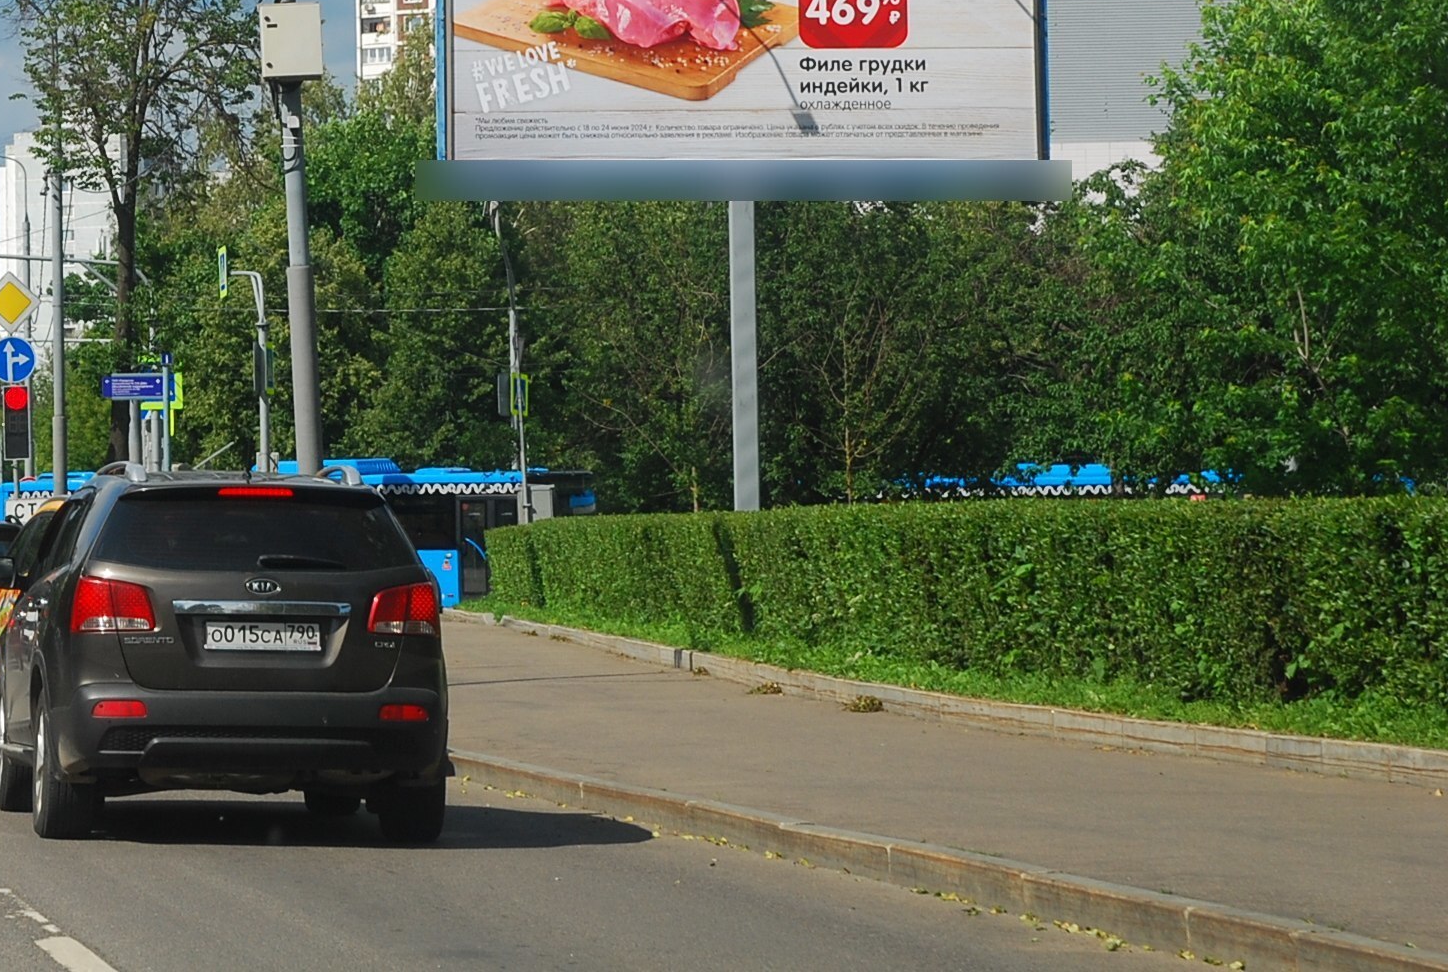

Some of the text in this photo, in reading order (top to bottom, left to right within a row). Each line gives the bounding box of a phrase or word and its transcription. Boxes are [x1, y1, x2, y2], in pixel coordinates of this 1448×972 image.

[472, 40, 561, 82] #WE LOVE
[799, 56, 926, 76] Филе грудки
[800, 78, 929, 96] индейки, 1 кг
[799, 99, 892, 112] охлажденное
[14, 502, 37, 519] СТ
[252, 582, 274, 592] KIA
[287, 625, 315, 640] 790
